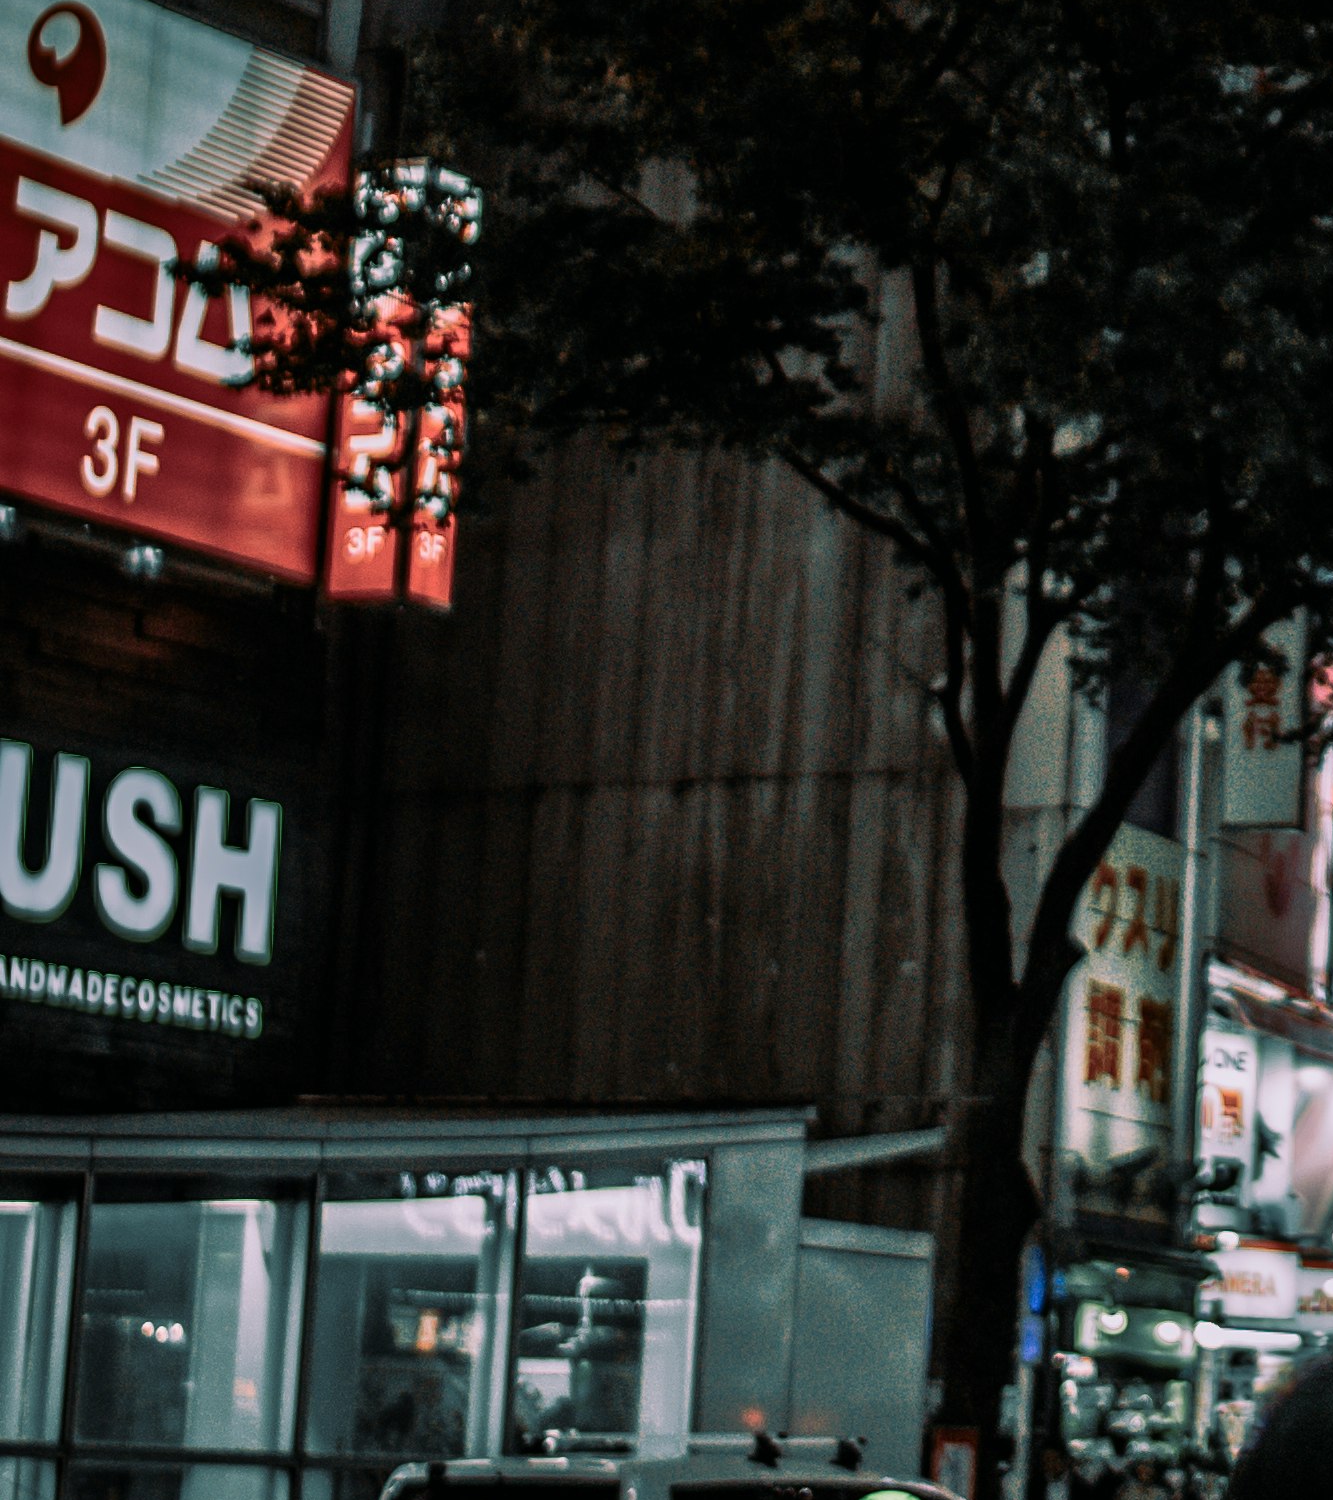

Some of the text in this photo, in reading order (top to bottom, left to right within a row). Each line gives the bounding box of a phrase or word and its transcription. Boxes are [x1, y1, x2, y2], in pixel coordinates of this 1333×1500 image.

[5, 175, 257, 388] アコム
[80, 405, 166, 503] 3F
[346, 525, 385, 560] 3F
